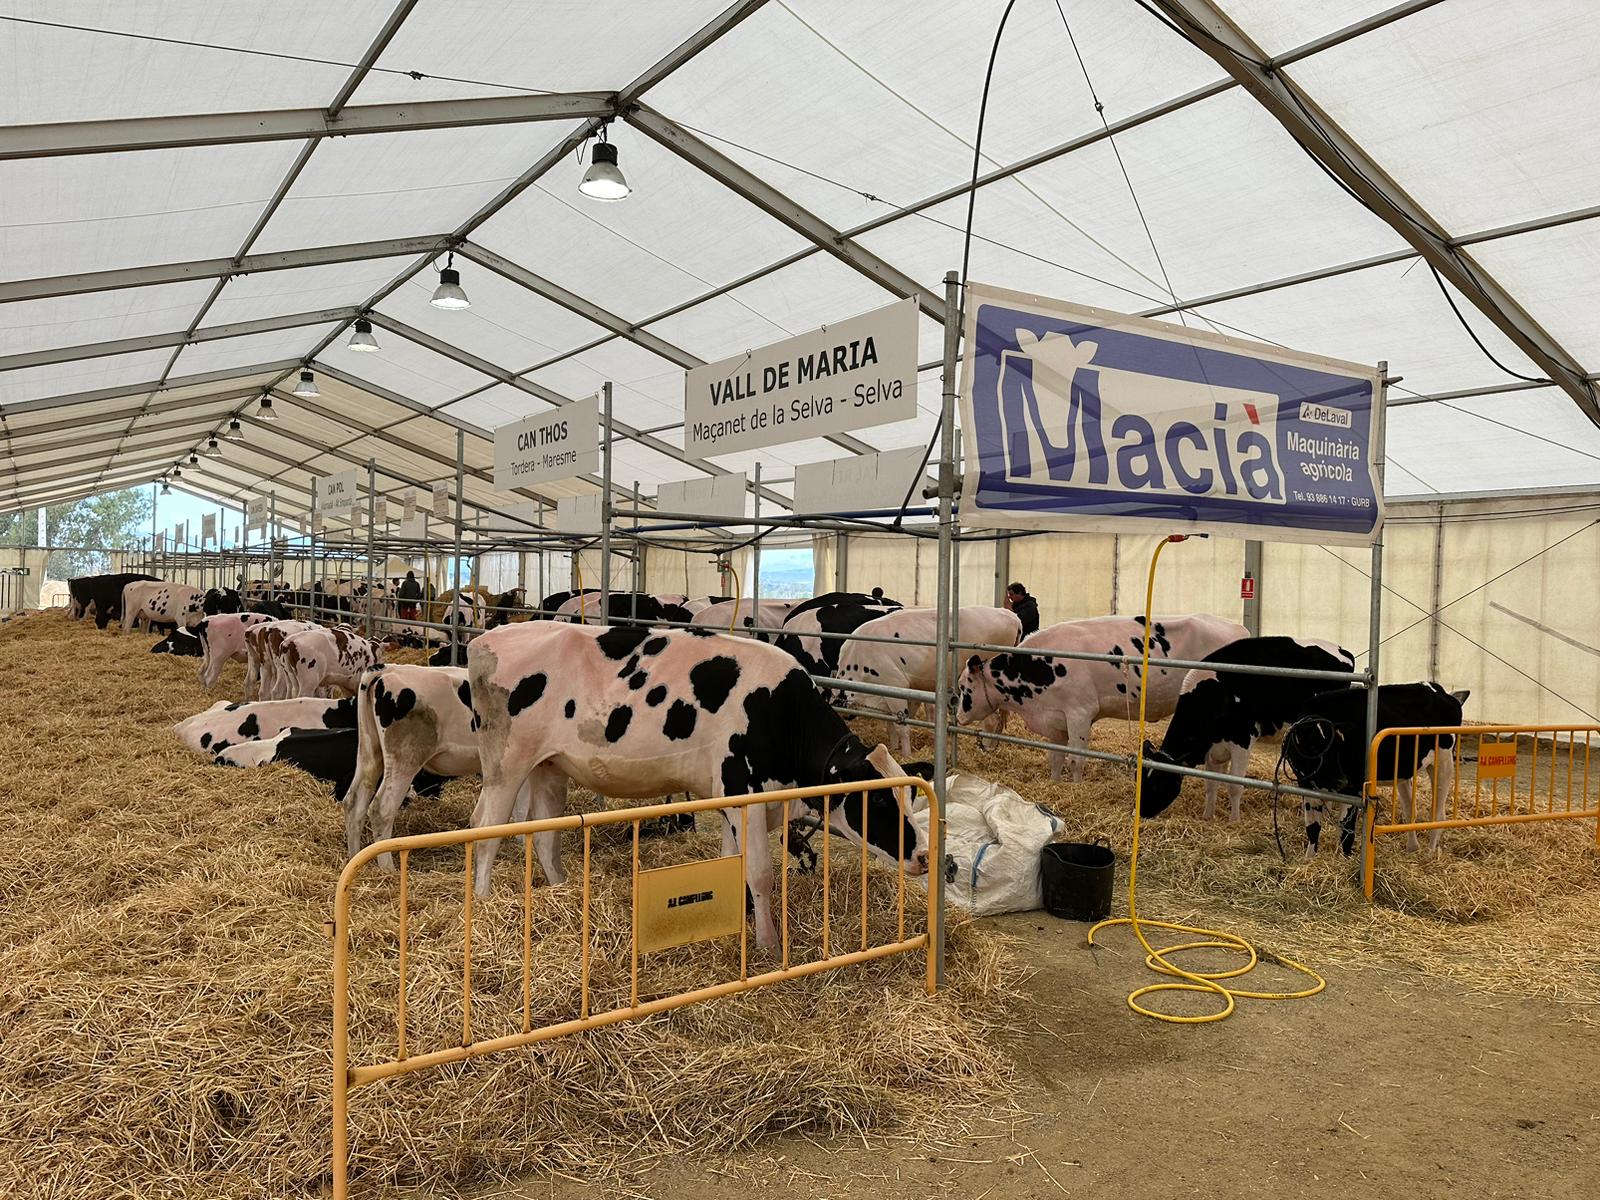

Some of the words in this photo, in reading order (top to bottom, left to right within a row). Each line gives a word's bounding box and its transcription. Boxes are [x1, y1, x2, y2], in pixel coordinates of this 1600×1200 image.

[710, 373, 756, 406] VALL
[763, 361, 790, 394] DE
[797, 336, 878, 385] MARIA
[692, 413, 746, 444] Maçanet
[750, 408, 767, 430] de
[773, 404, 785, 425] la
[790, 395, 833, 422] Selva
[854, 378, 903, 408] Selva
[1314, 407, 1348, 425] DeLaval
[517, 429, 537, 452] CAN
[539, 420, 568, 446] THOS
[1002, 355, 1285, 501] Macià
[1286, 431, 1360, 461] Maquinària
[510, 459, 535, 476] Tordera
[542, 450, 577, 469] Maresme
[1292, 490, 1306, 501] Tel.
[1306, 492, 1315, 503] 93
[1329, 495, 1337, 504] 14
[1338, 496, 1346, 505] 17
[1351, 496, 1370, 508] GURB
